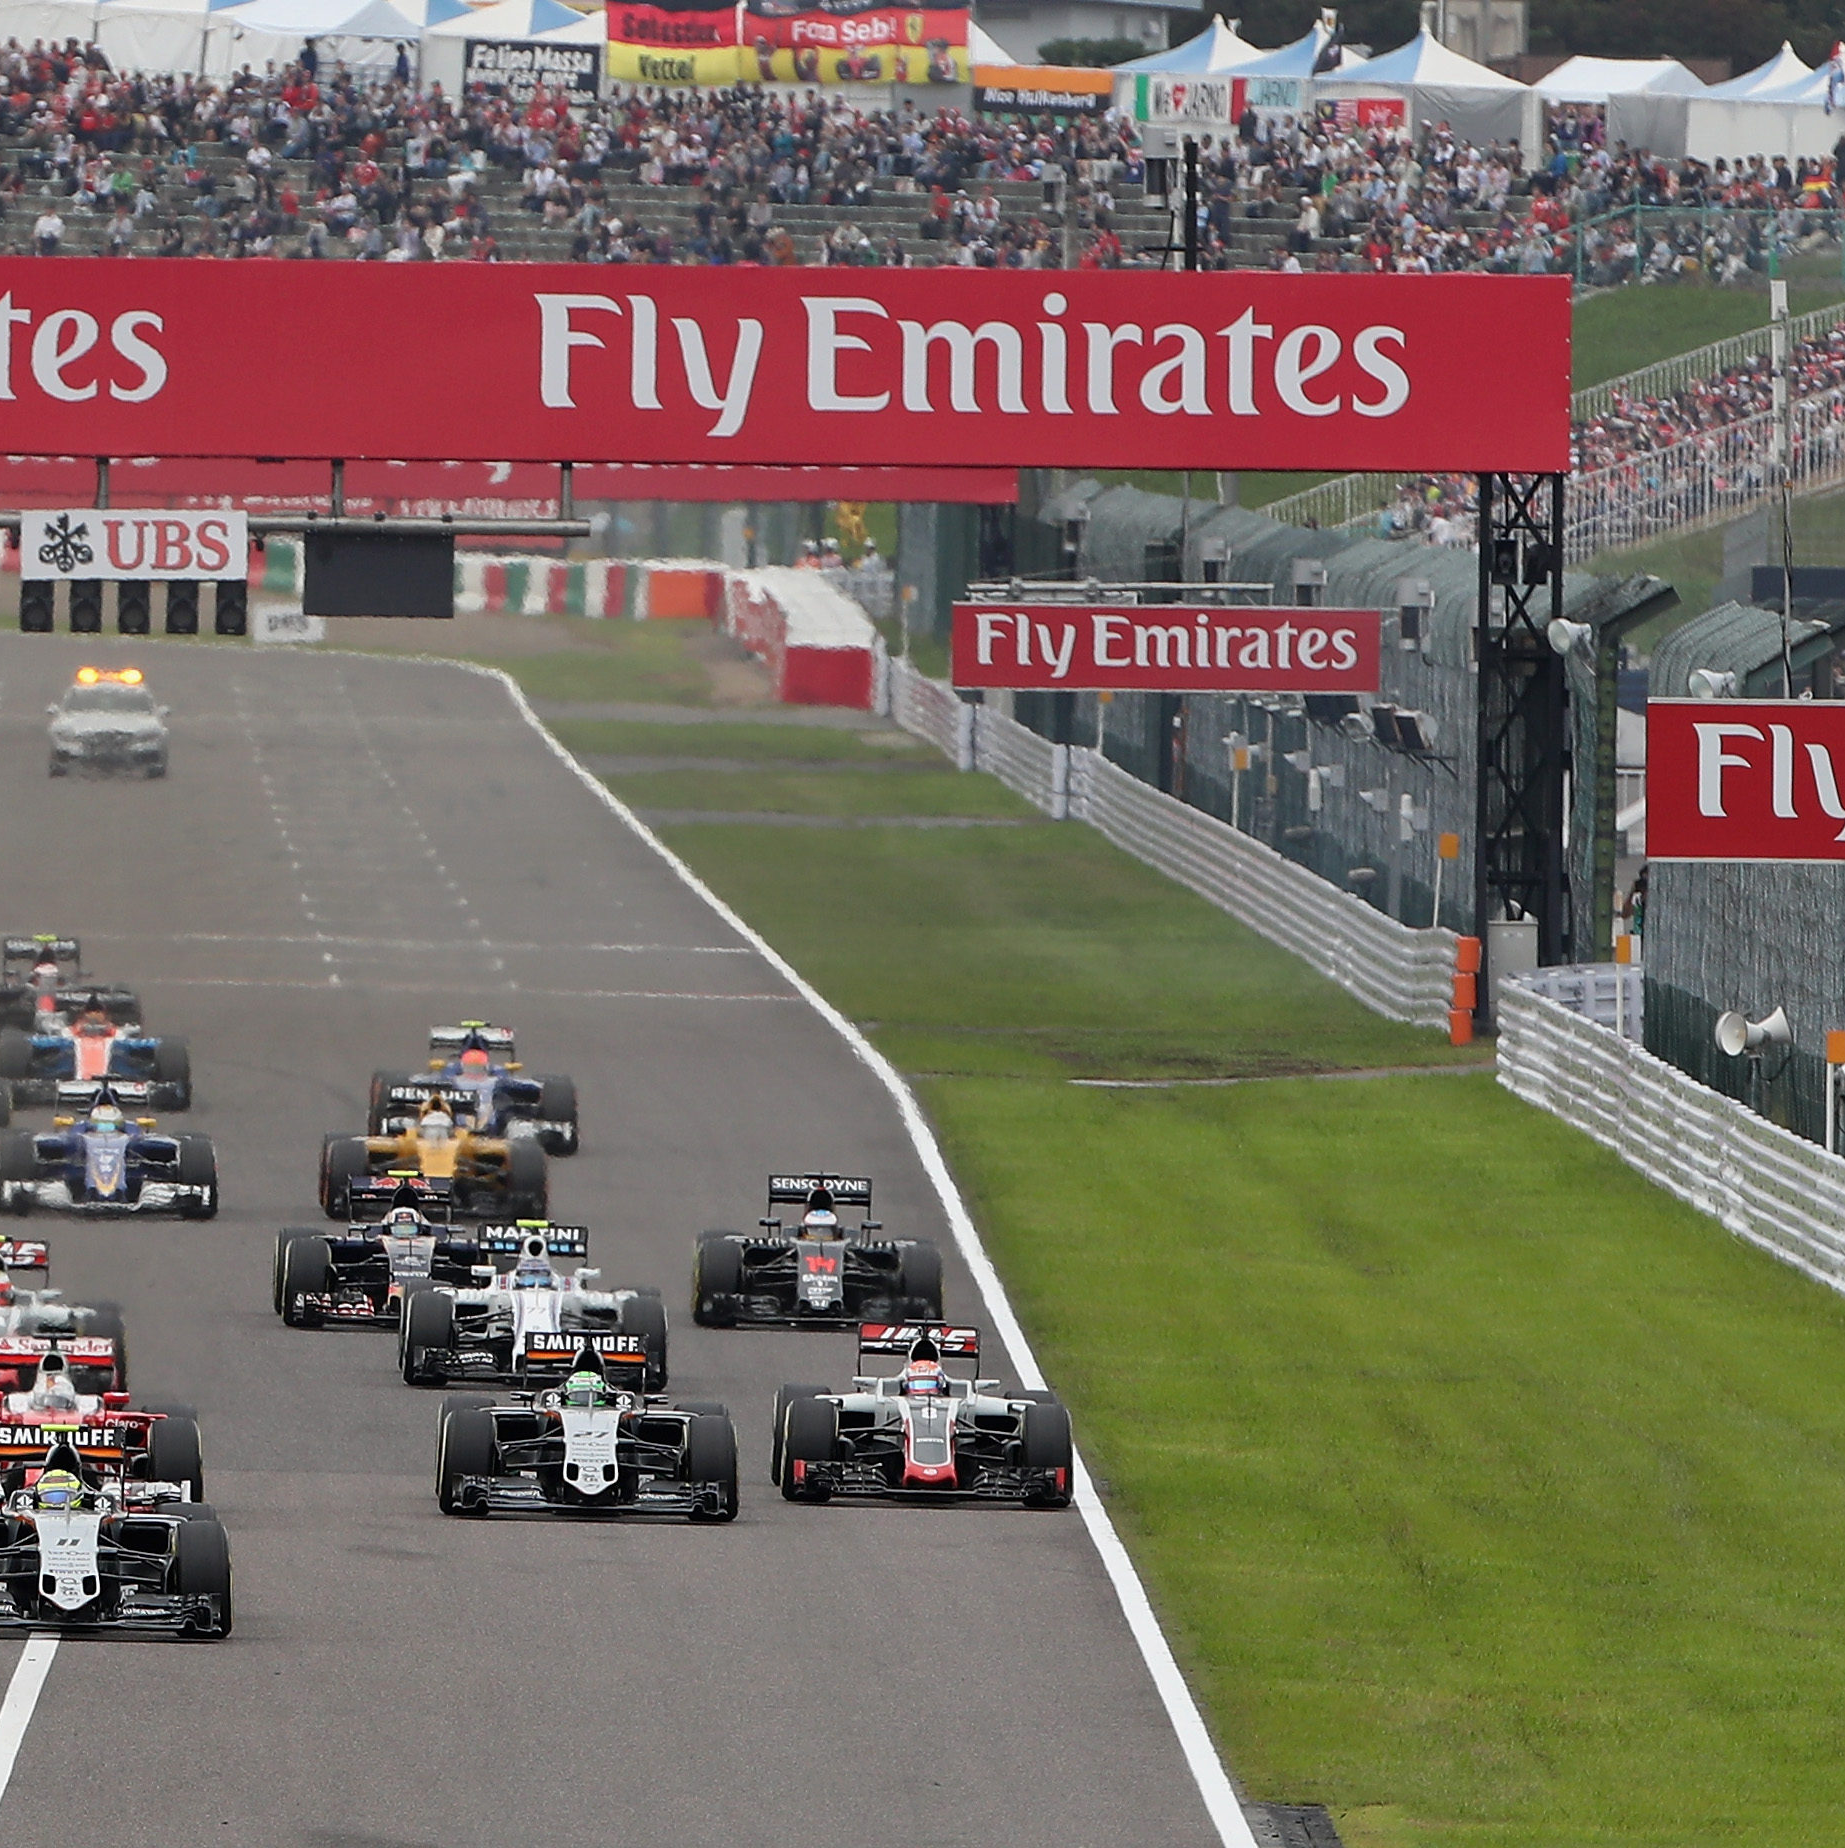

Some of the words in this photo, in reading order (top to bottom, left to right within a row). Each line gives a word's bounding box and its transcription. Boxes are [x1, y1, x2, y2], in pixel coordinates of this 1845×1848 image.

[840, 16, 897, 42] Seb!
[533, 46, 594, 73] Massa
[535, 293, 763, 437] Fly
[801, 292, 1410, 417] Emirates
[106, 521, 229, 570] UBS
[975, 612, 1076, 678] Fly
[1091, 613, 1358, 670] Emirates
[390, 1086, 475, 1103] RENULT
[771, 1177, 869, 1192] SENSODYNE
[485, 1225, 581, 1242] MARTINI
[19, 1339, 111, 1353] Sanander
[533, 1334, 639, 1352] SMIRNOFF
[105, 1418, 140, 1429] Claro
[572, 1430, 610, 1440] 27
